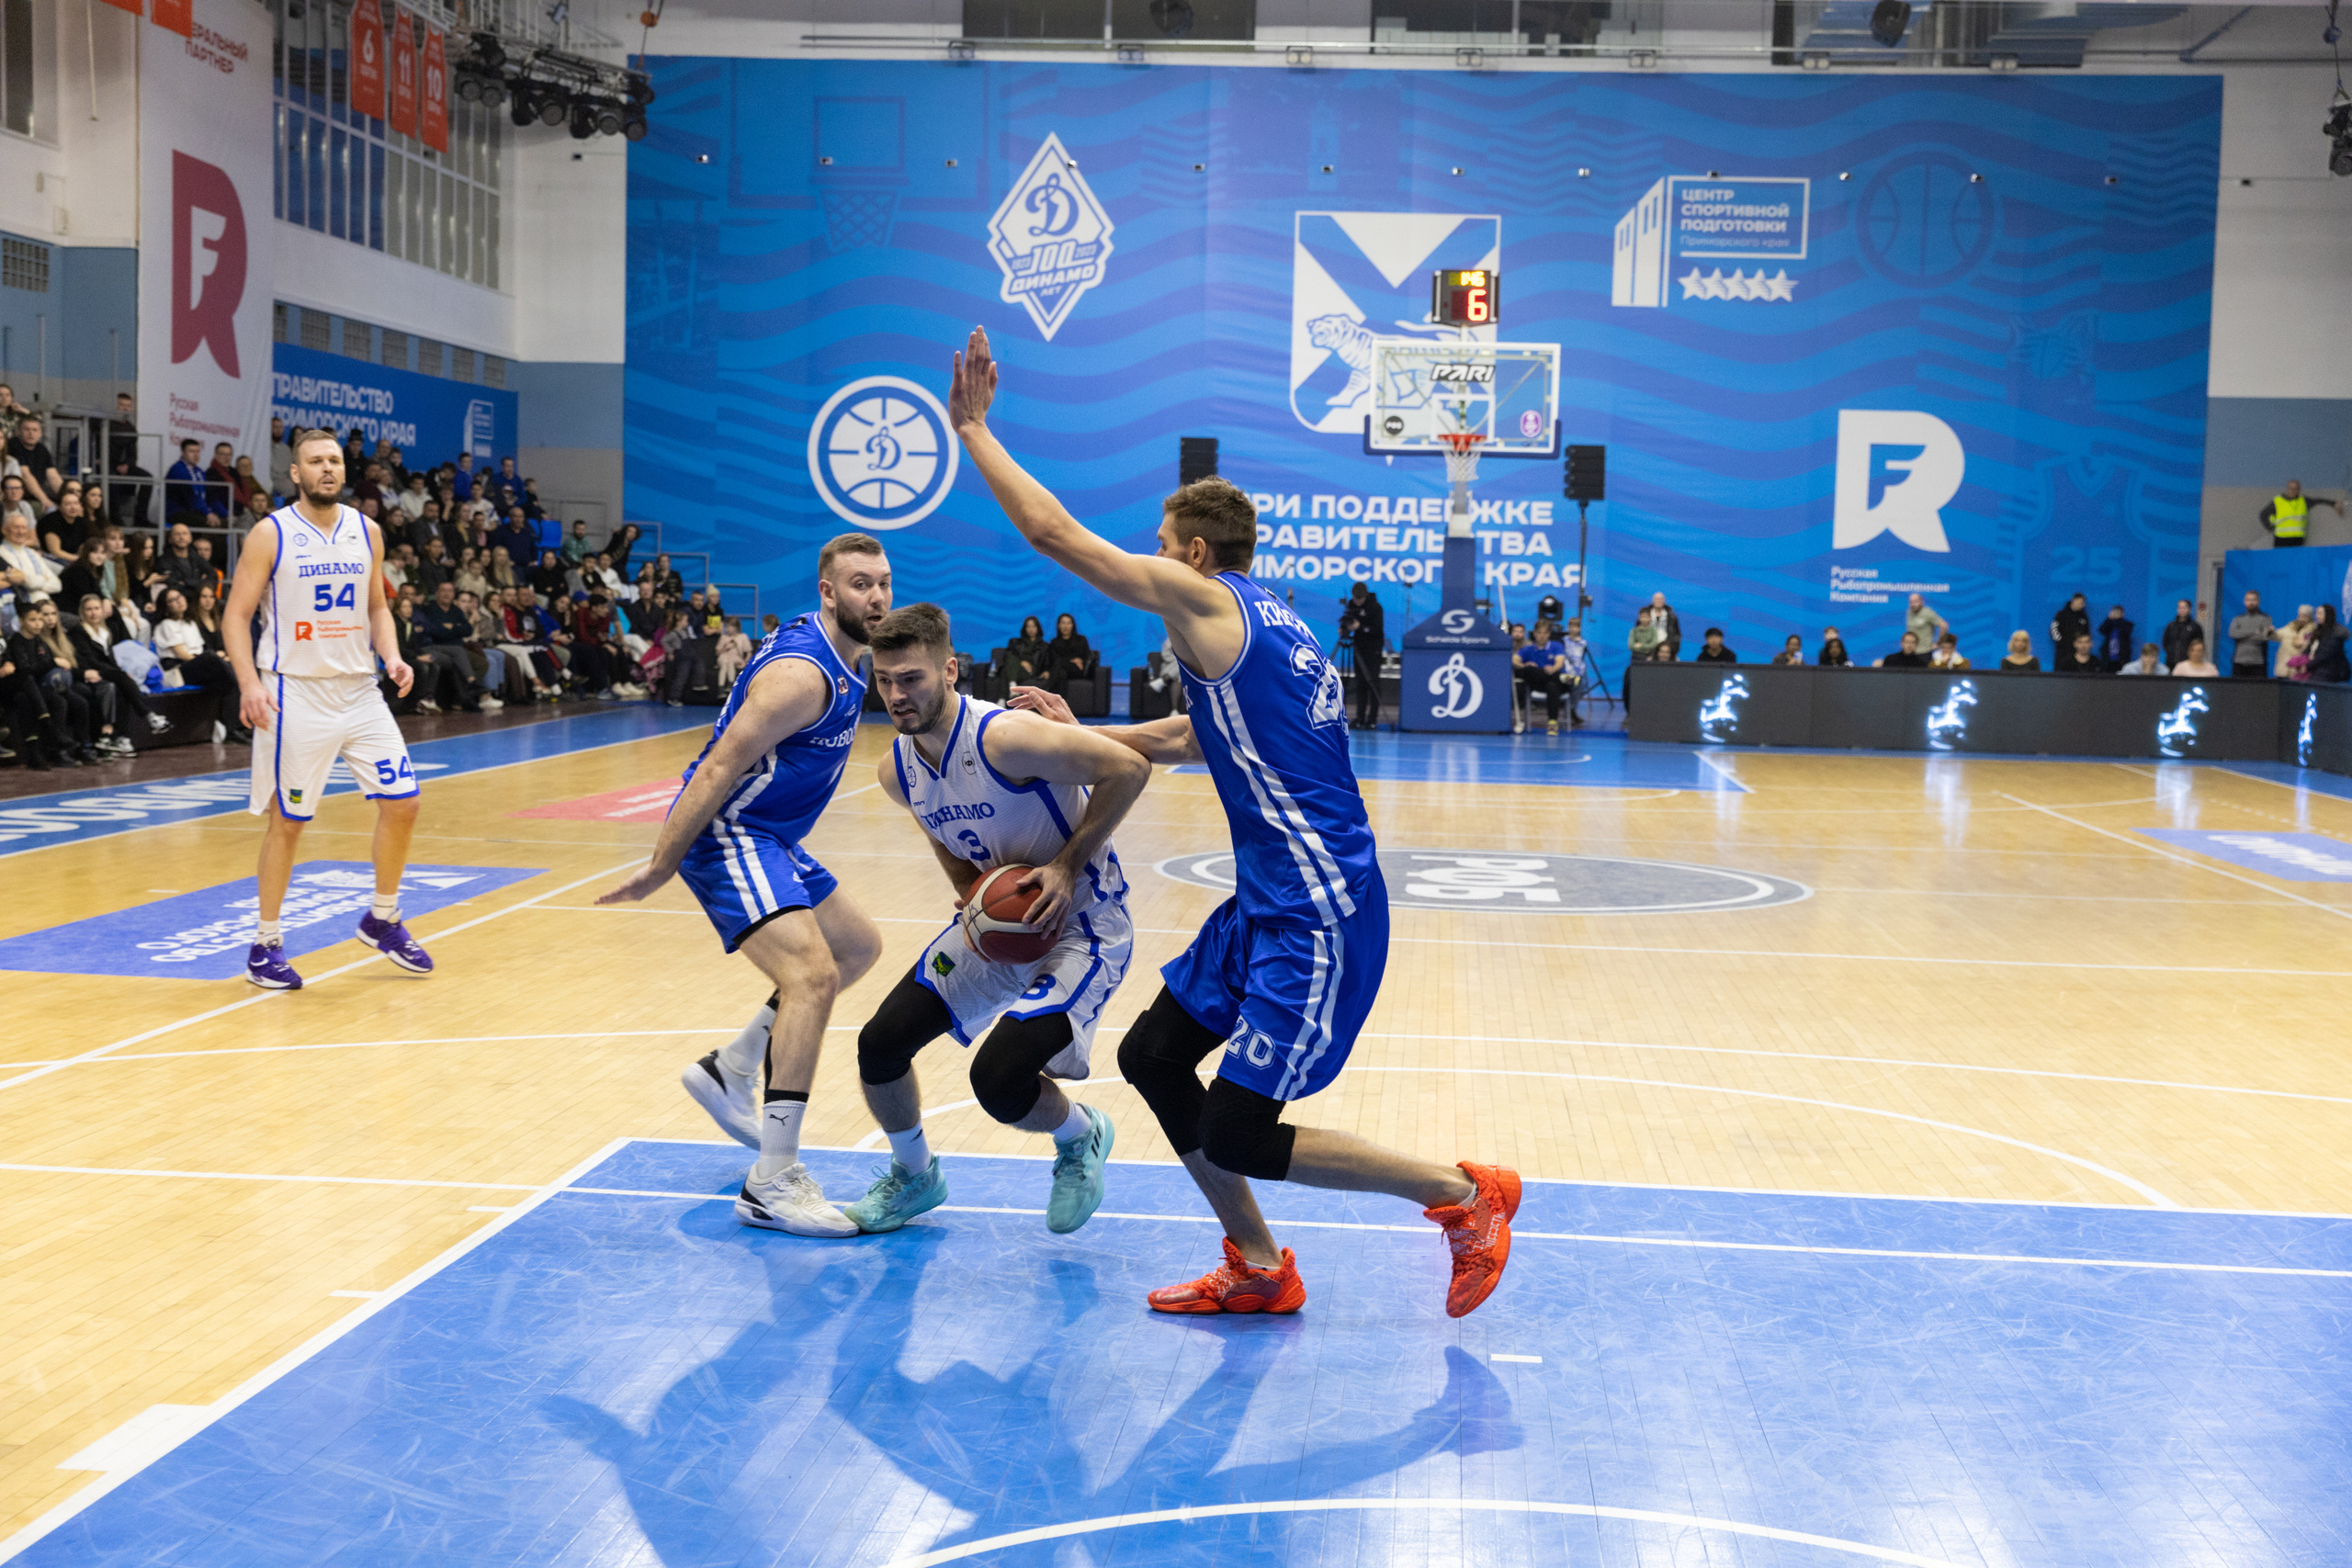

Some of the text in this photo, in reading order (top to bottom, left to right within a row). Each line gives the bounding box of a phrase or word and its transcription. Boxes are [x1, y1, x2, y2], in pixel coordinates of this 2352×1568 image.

[362, 28, 375, 64] 6
[399, 50, 412, 85] 11
[427, 65, 443, 102] 10
[1680, 202, 1790, 218] СПОРТИВНОЙ
[1682, 188, 1735, 202] ЦЕНТР
[1680, 218, 1787, 233] ПОДГОТОВКИ
[1010, 264, 1096, 294] ДИНАМО
[1467, 288, 1488, 321] 6
[1431, 365, 1495, 382] PARI
[1247, 493, 1301, 518] РИ
[1255, 524, 1554, 557] РАВИТЕЛЬТВА
[299, 562, 365, 579] ДИНАМО
[1249, 554, 1587, 588] ИМОРСКОГ КРАЯ
[313, 582, 356, 613] 54
[374, 755, 415, 785] 54
[921, 802, 996, 830] ИНАМО
[956, 829, 991, 862] 3
[1226, 1014, 1276, 1070] 20
